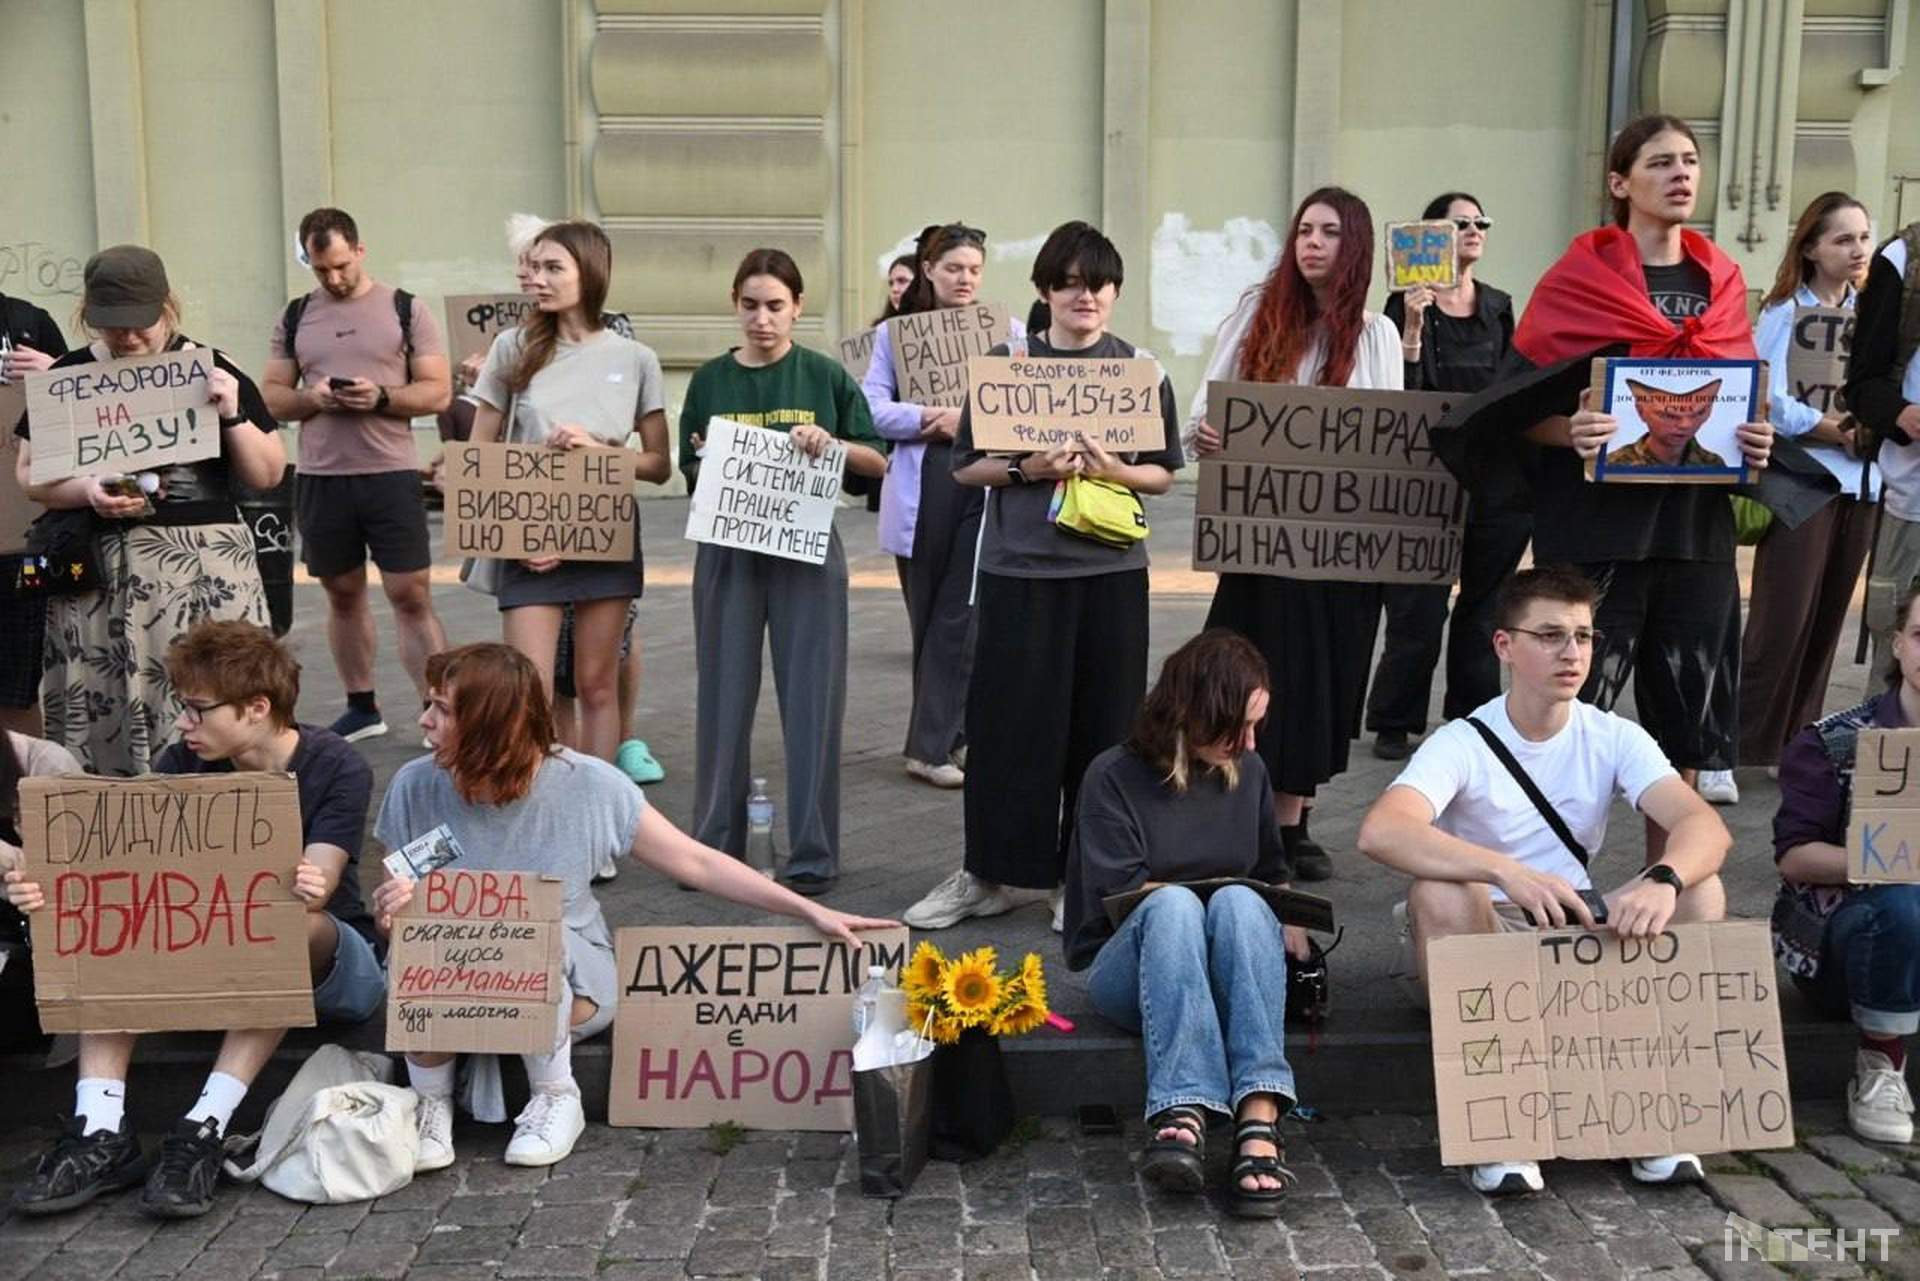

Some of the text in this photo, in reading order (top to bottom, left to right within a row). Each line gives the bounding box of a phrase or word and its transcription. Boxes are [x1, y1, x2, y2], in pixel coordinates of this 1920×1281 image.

[899, 306, 995, 343] МИ НЕ В
[48, 359, 208, 402] ФЕДОРОВА
[909, 367, 961, 399] А ВИ
[978, 382, 1053, 416] СТОП
[78, 408, 197, 466] БАЗУ!
[96, 403, 131, 428] НА
[1223, 397, 1450, 464] РУСНЯ РАД
[463, 448, 622, 485] Я ВЖЕ НЕ
[732, 427, 843, 473] НАХУЯ НІ
[458, 489, 634, 522] ВИВОЗЮ ВСЮ
[810, 475, 839, 499] ЩО
[1220, 465, 1323, 516] НАТО
[1334, 471, 1361, 514] В
[459, 523, 615, 553] ЦЮ БАЙДУ
[712, 515, 829, 558] ПРОТИ МЕНЕ
[1197, 517, 1242, 564] ВИ
[1253, 525, 1296, 568] НА
[1875, 734, 1910, 795] У
[1862, 822, 1920, 875] КА
[55, 871, 280, 957] ВБИВАЄ
[425, 872, 530, 919] ВОВА,
[444, 946, 504, 968] щось
[626, 941, 904, 997] ДЖЕРЕЛОМ
[1540, 931, 1679, 964] TO DO
[696, 1002, 797, 1025] ВЛАДИ
[727, 1029, 744, 1046] Є
[638, 1047, 853, 1104] НАРОД
